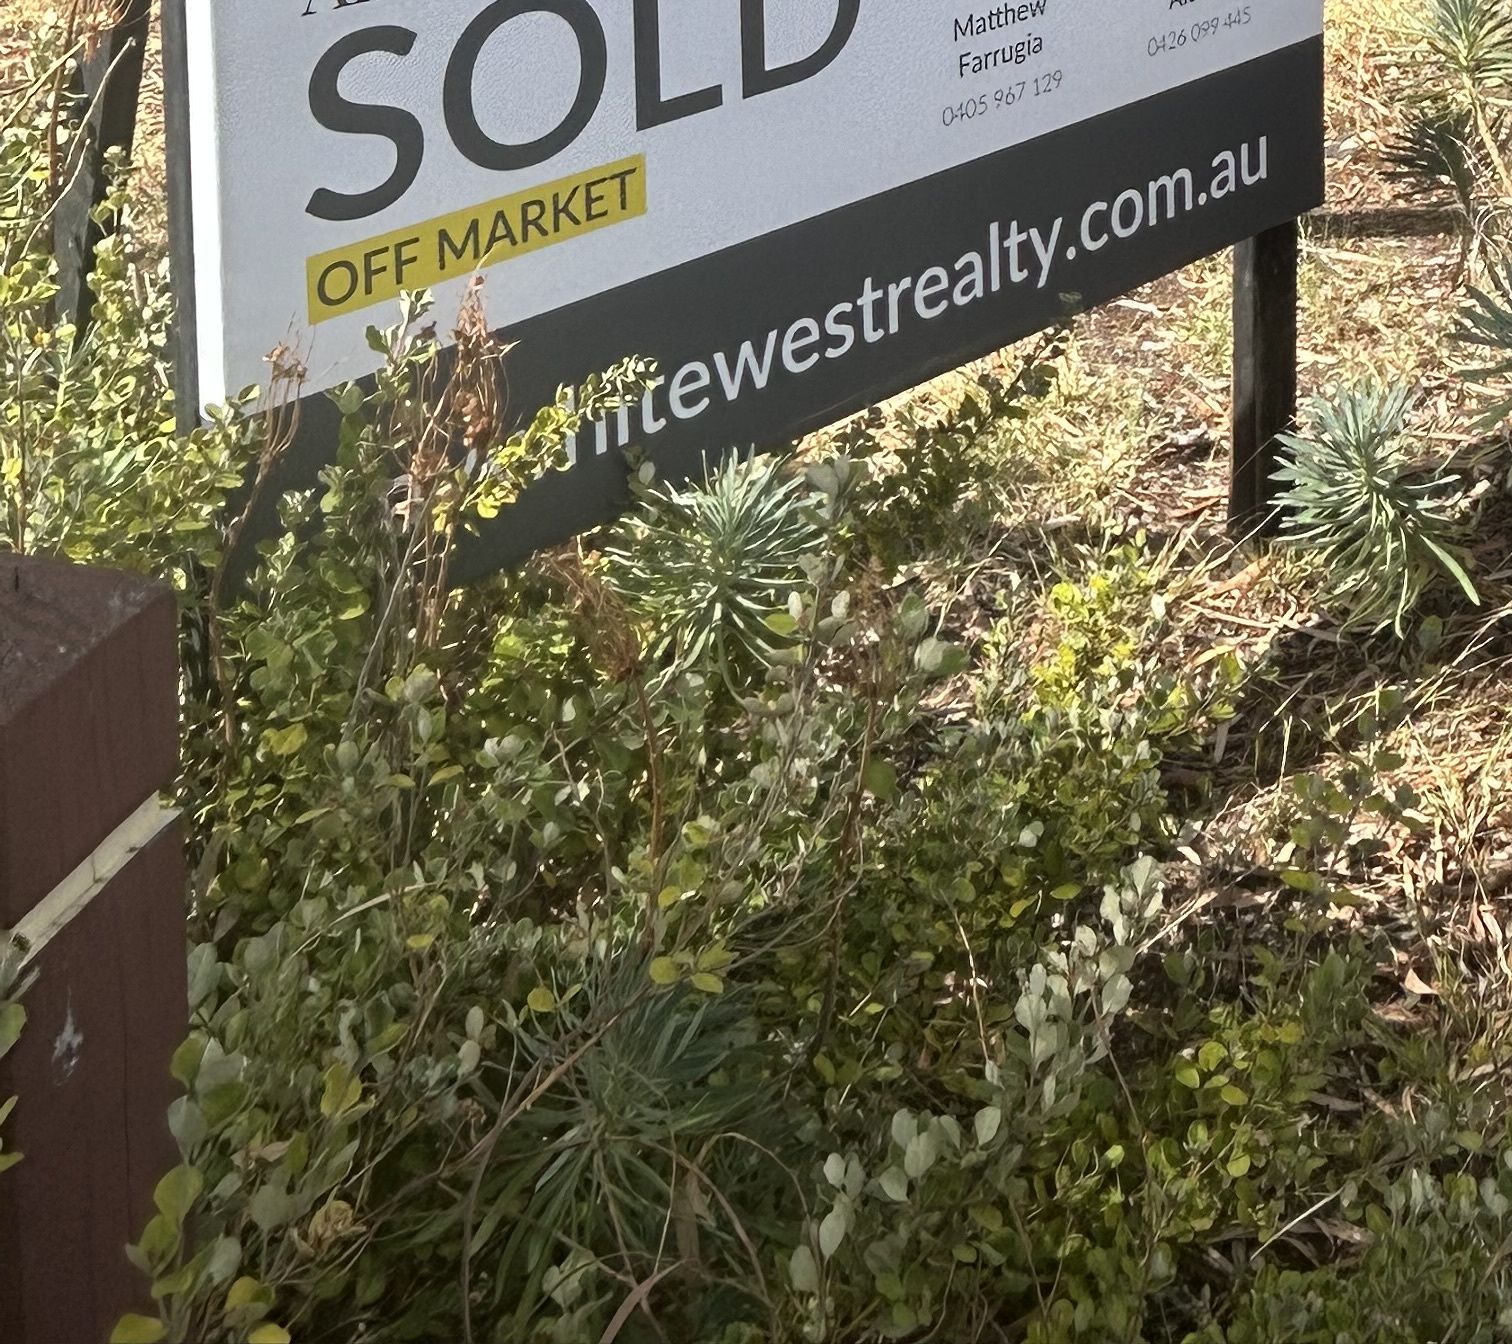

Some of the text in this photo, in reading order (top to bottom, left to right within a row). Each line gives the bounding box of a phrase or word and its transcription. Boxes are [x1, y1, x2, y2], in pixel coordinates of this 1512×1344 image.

[958, 32, 1044, 79] Farrugia
[1147, 29, 1187, 57] 0426
[1191, 17, 1220, 42] 099
[942, 70, 1063, 127] 0405 967 129
[315, 167, 639, 308] OFF MARKET
